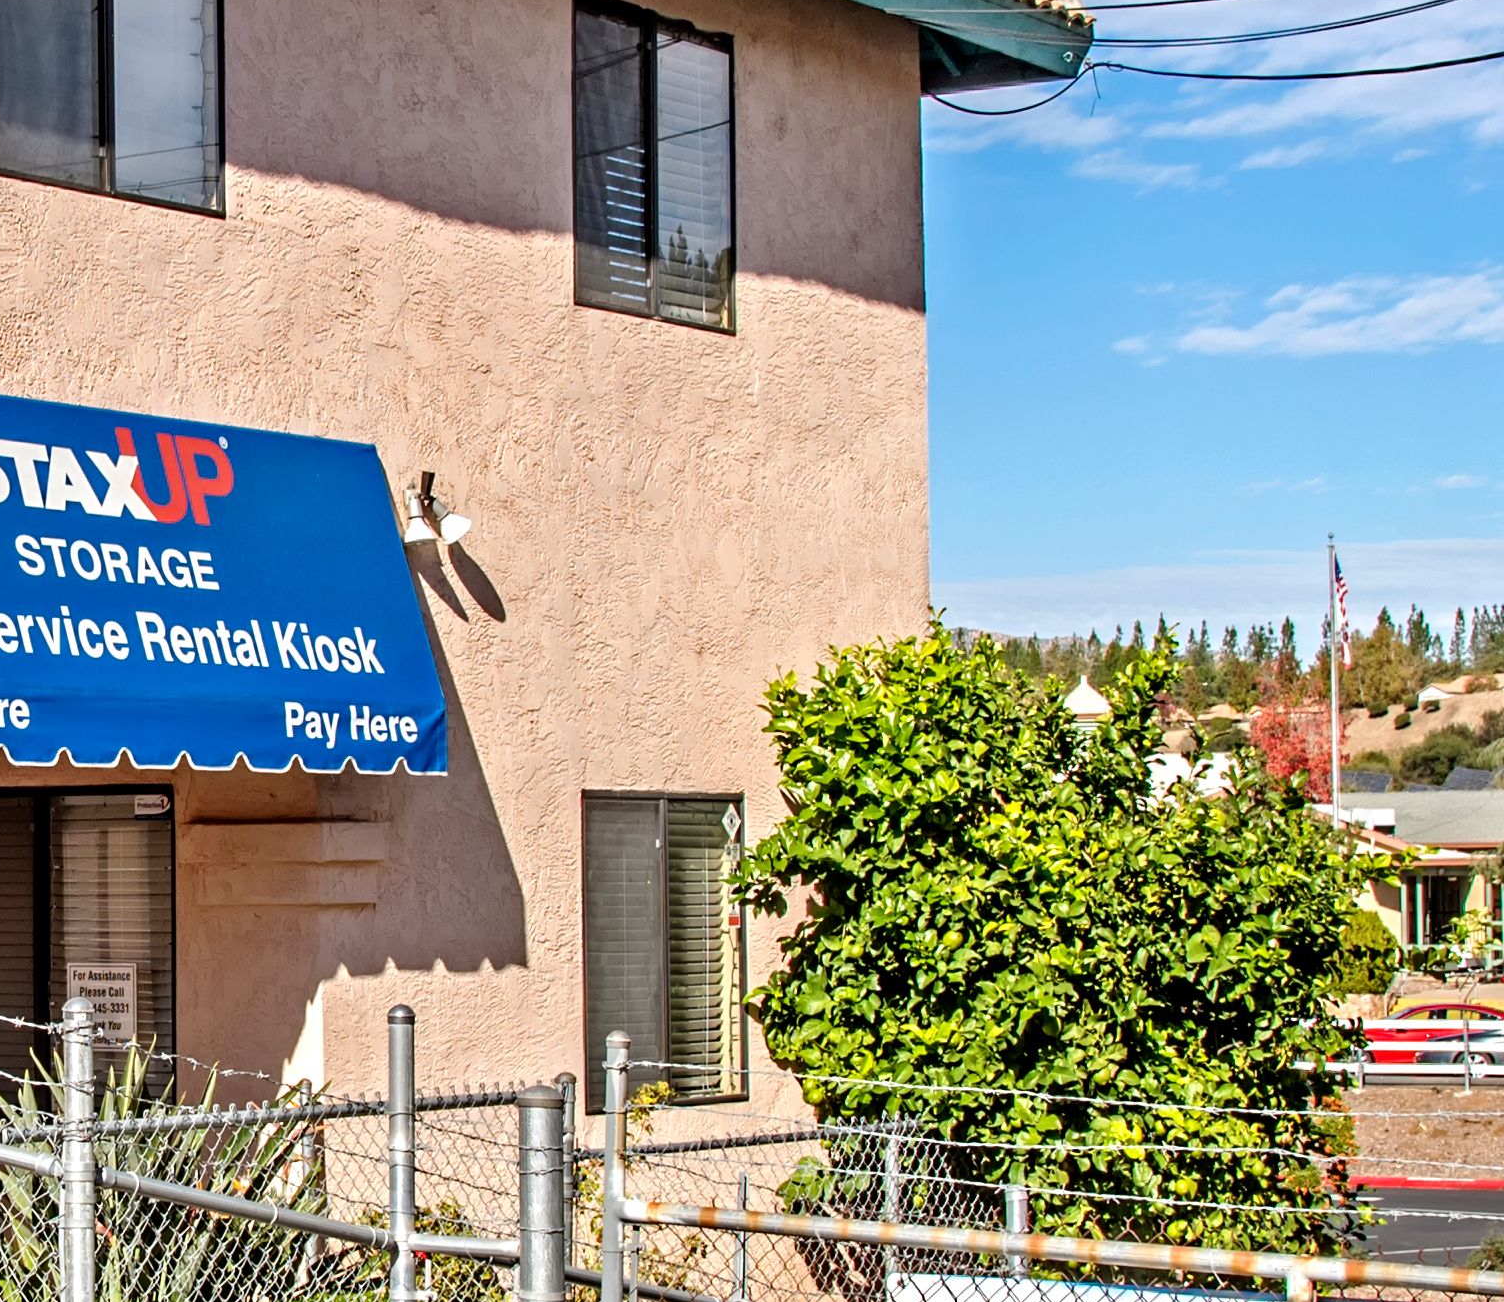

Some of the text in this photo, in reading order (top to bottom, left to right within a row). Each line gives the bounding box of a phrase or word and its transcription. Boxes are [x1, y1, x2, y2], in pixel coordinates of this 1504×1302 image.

[15, 534, 220, 590] STORAGE
[135, 611, 270, 667] Rental
[272, 621, 386, 674] Kiosk
[284, 701, 418, 749] Pay Here
[73, 970, 131, 981] For Assistance
[79, 986, 125, 997] Please Call
[108, 1020, 122, 1031] You
